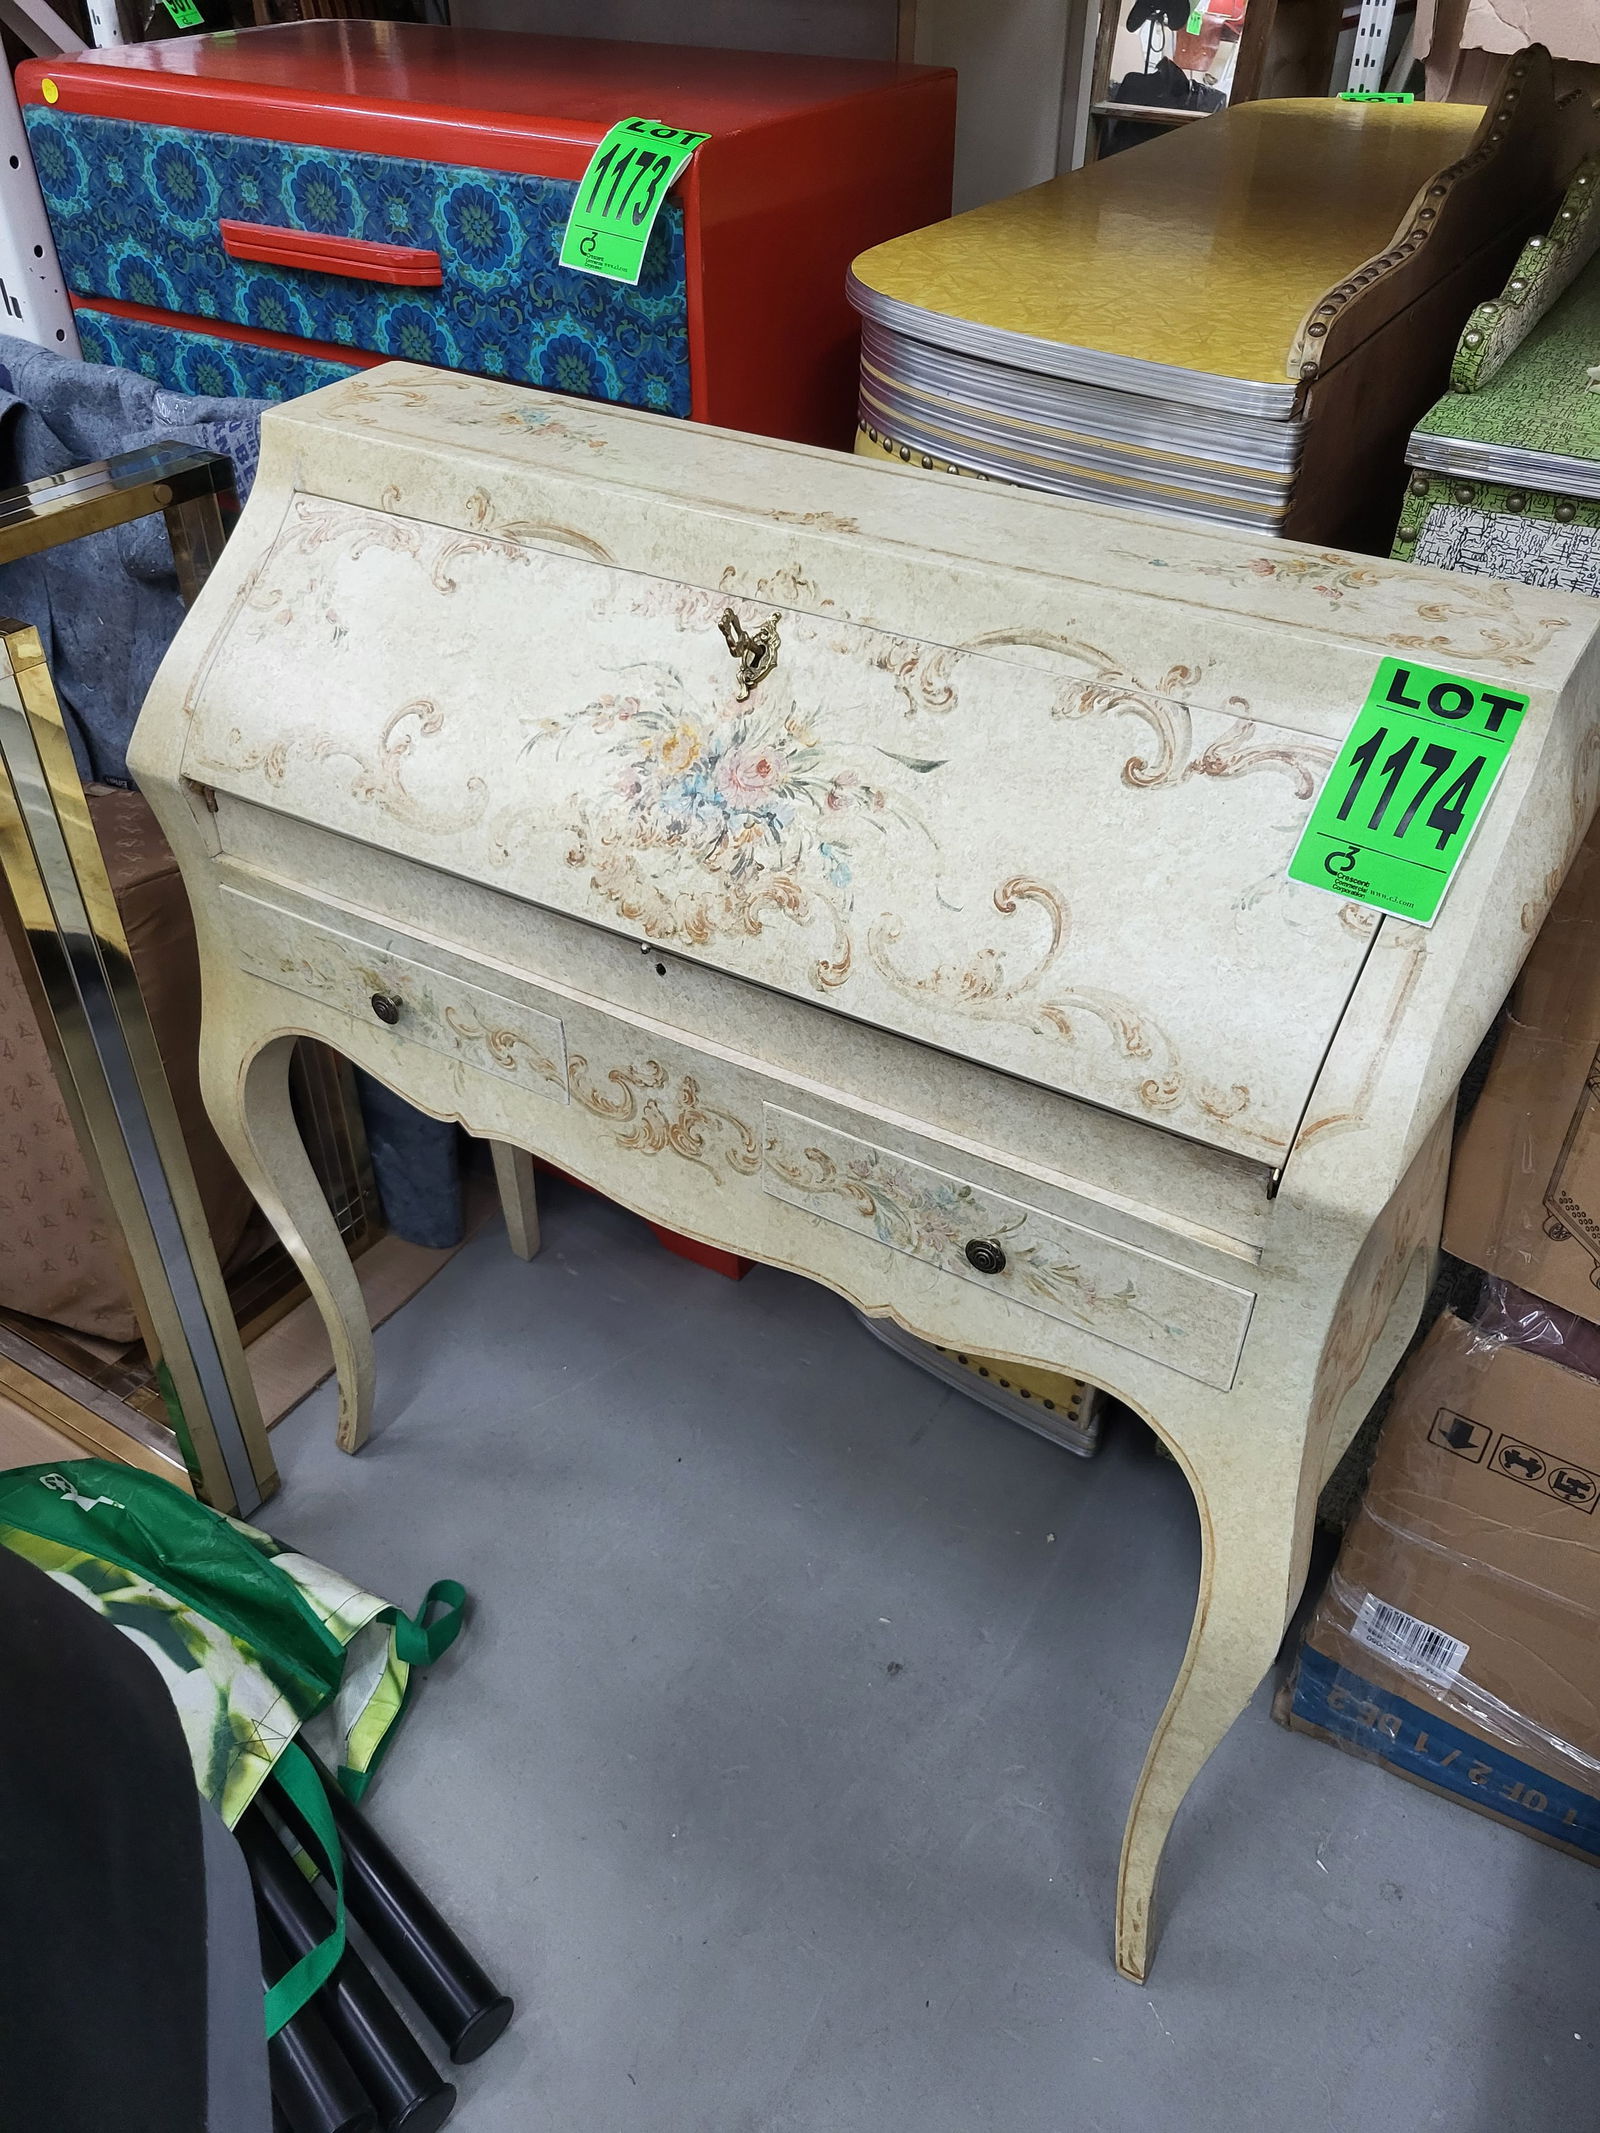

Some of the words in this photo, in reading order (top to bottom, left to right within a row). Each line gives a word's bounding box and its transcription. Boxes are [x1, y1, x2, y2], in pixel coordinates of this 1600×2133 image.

[626, 121, 706, 146] LOT
[585, 143, 672, 227] 1173
[1385, 668, 1525, 733] LOT
[1336, 726, 1487, 851] 1174
[1332, 883, 1366, 900] Corporation
[1334, 878, 1369, 894] Commercial
[1336, 871, 1370, 888] Crescent
[1327, 1684, 1350, 1711] 2
[1355, 1700, 1403, 1736] DE
[1415, 1731, 1430, 1753] 1
[1467, 1759, 1493, 1785] 2
[1502, 1781, 1548, 1812] OF
